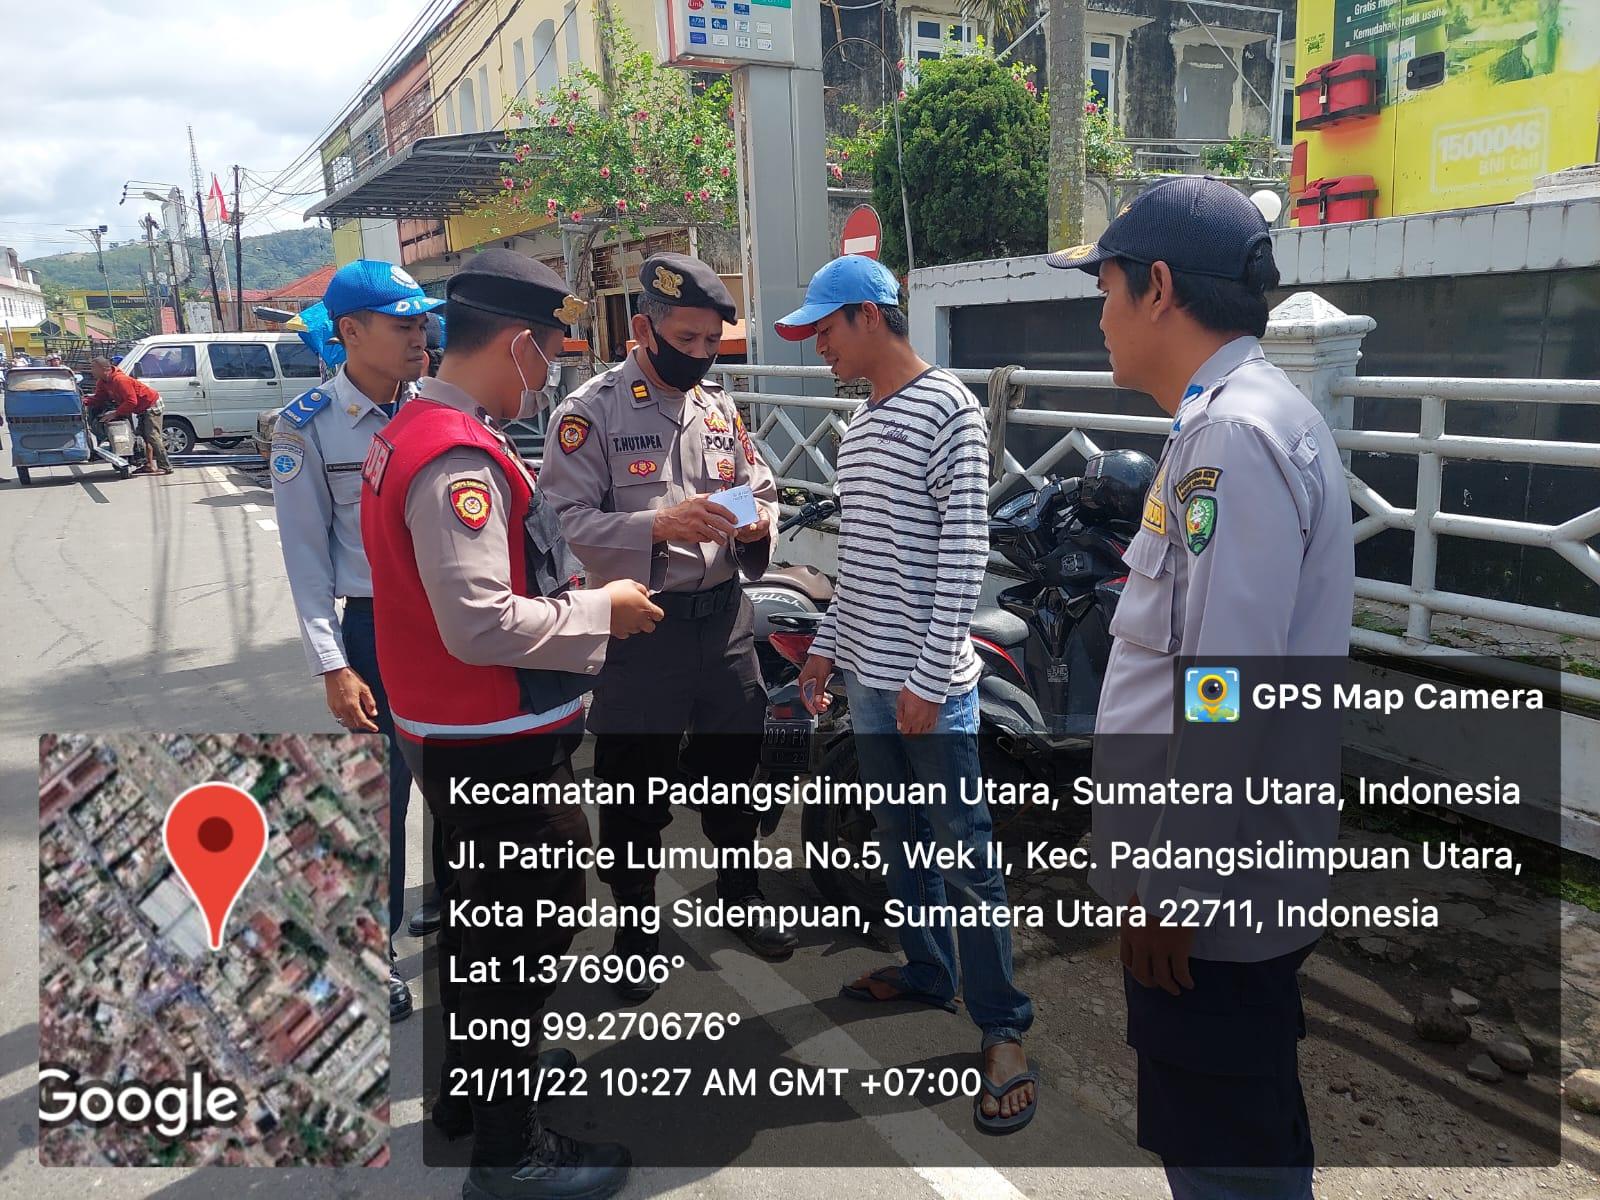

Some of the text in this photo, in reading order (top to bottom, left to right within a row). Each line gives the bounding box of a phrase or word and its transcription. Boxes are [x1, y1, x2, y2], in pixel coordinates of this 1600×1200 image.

[1354, 0, 1376, 15] Gratis
[1440, 120, 1541, 165] 1500046
[613, 434, 663, 453] T.HUTAPEA
